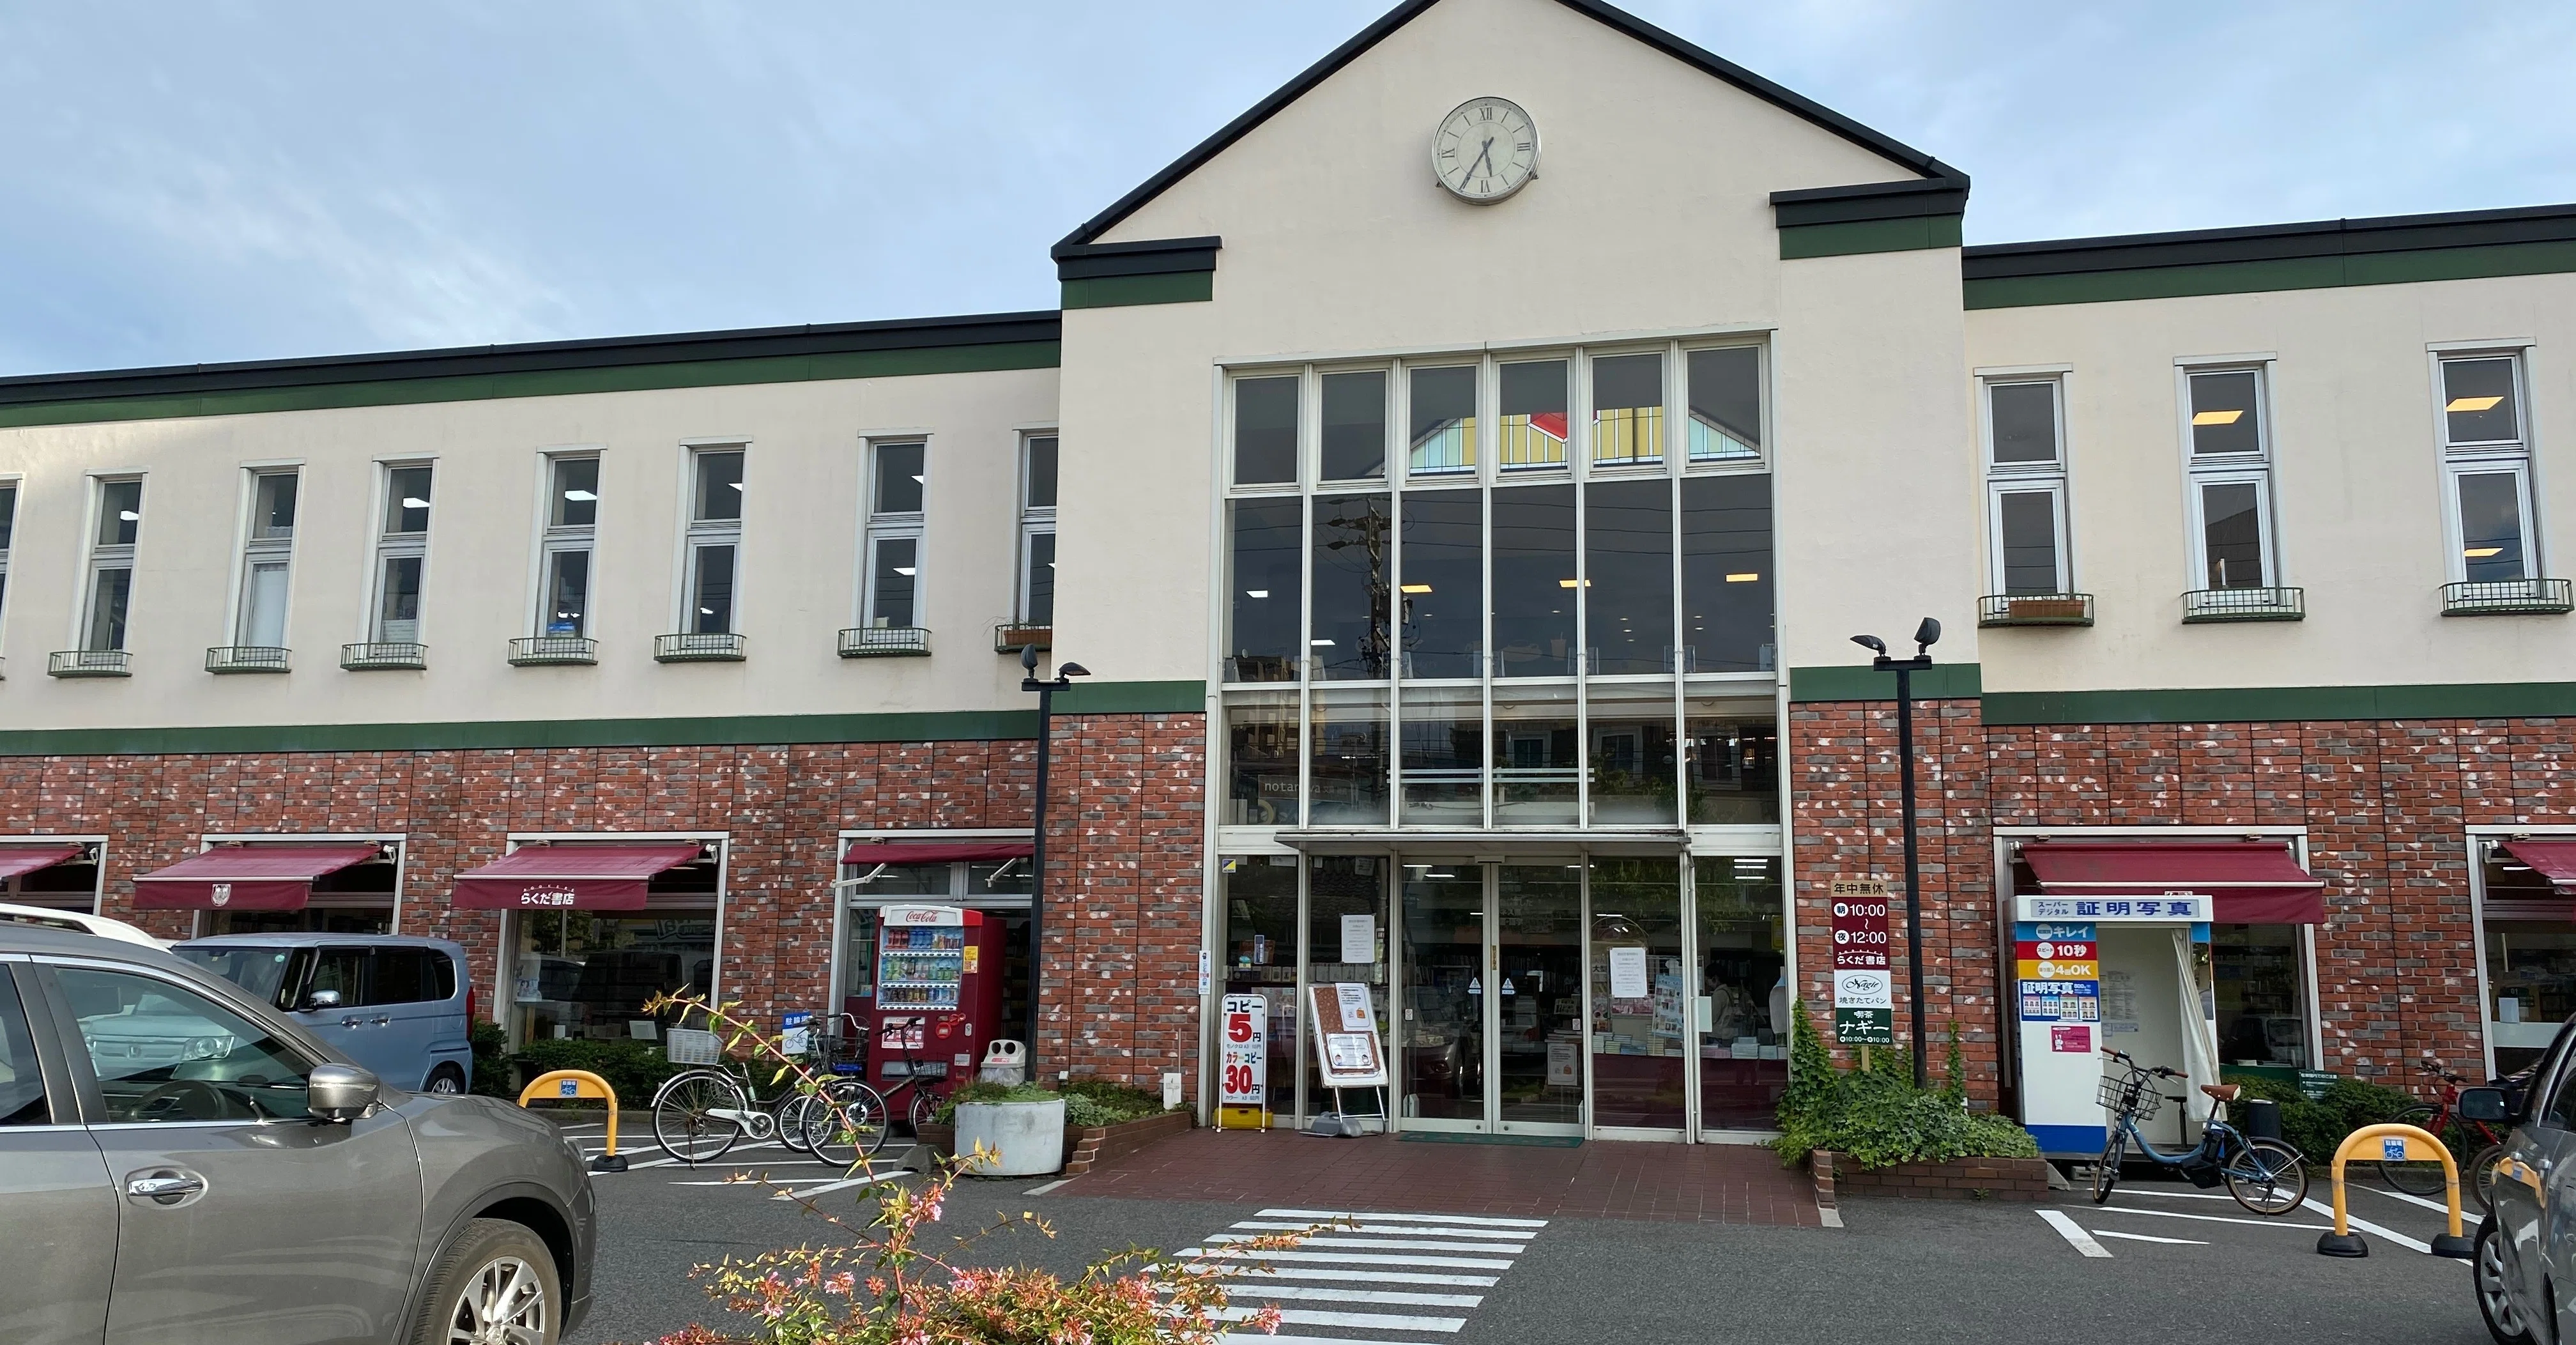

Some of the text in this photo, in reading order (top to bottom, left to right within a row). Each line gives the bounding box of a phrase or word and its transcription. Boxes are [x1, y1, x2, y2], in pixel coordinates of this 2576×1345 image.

[1834, 883, 1884, 895] 年中無休
[521, 891, 575, 905] らくだ書店
[2076, 902, 2192, 916] 証明写真
[1837, 955, 1886, 965] らくだ書店
[2022, 981, 2073, 994] 証明写真
[1227, 999, 1262, 1013] コピー
[1839, 1020, 1889, 1034] ナギー
[1226, 1051, 1262, 1064] カラーコピー
